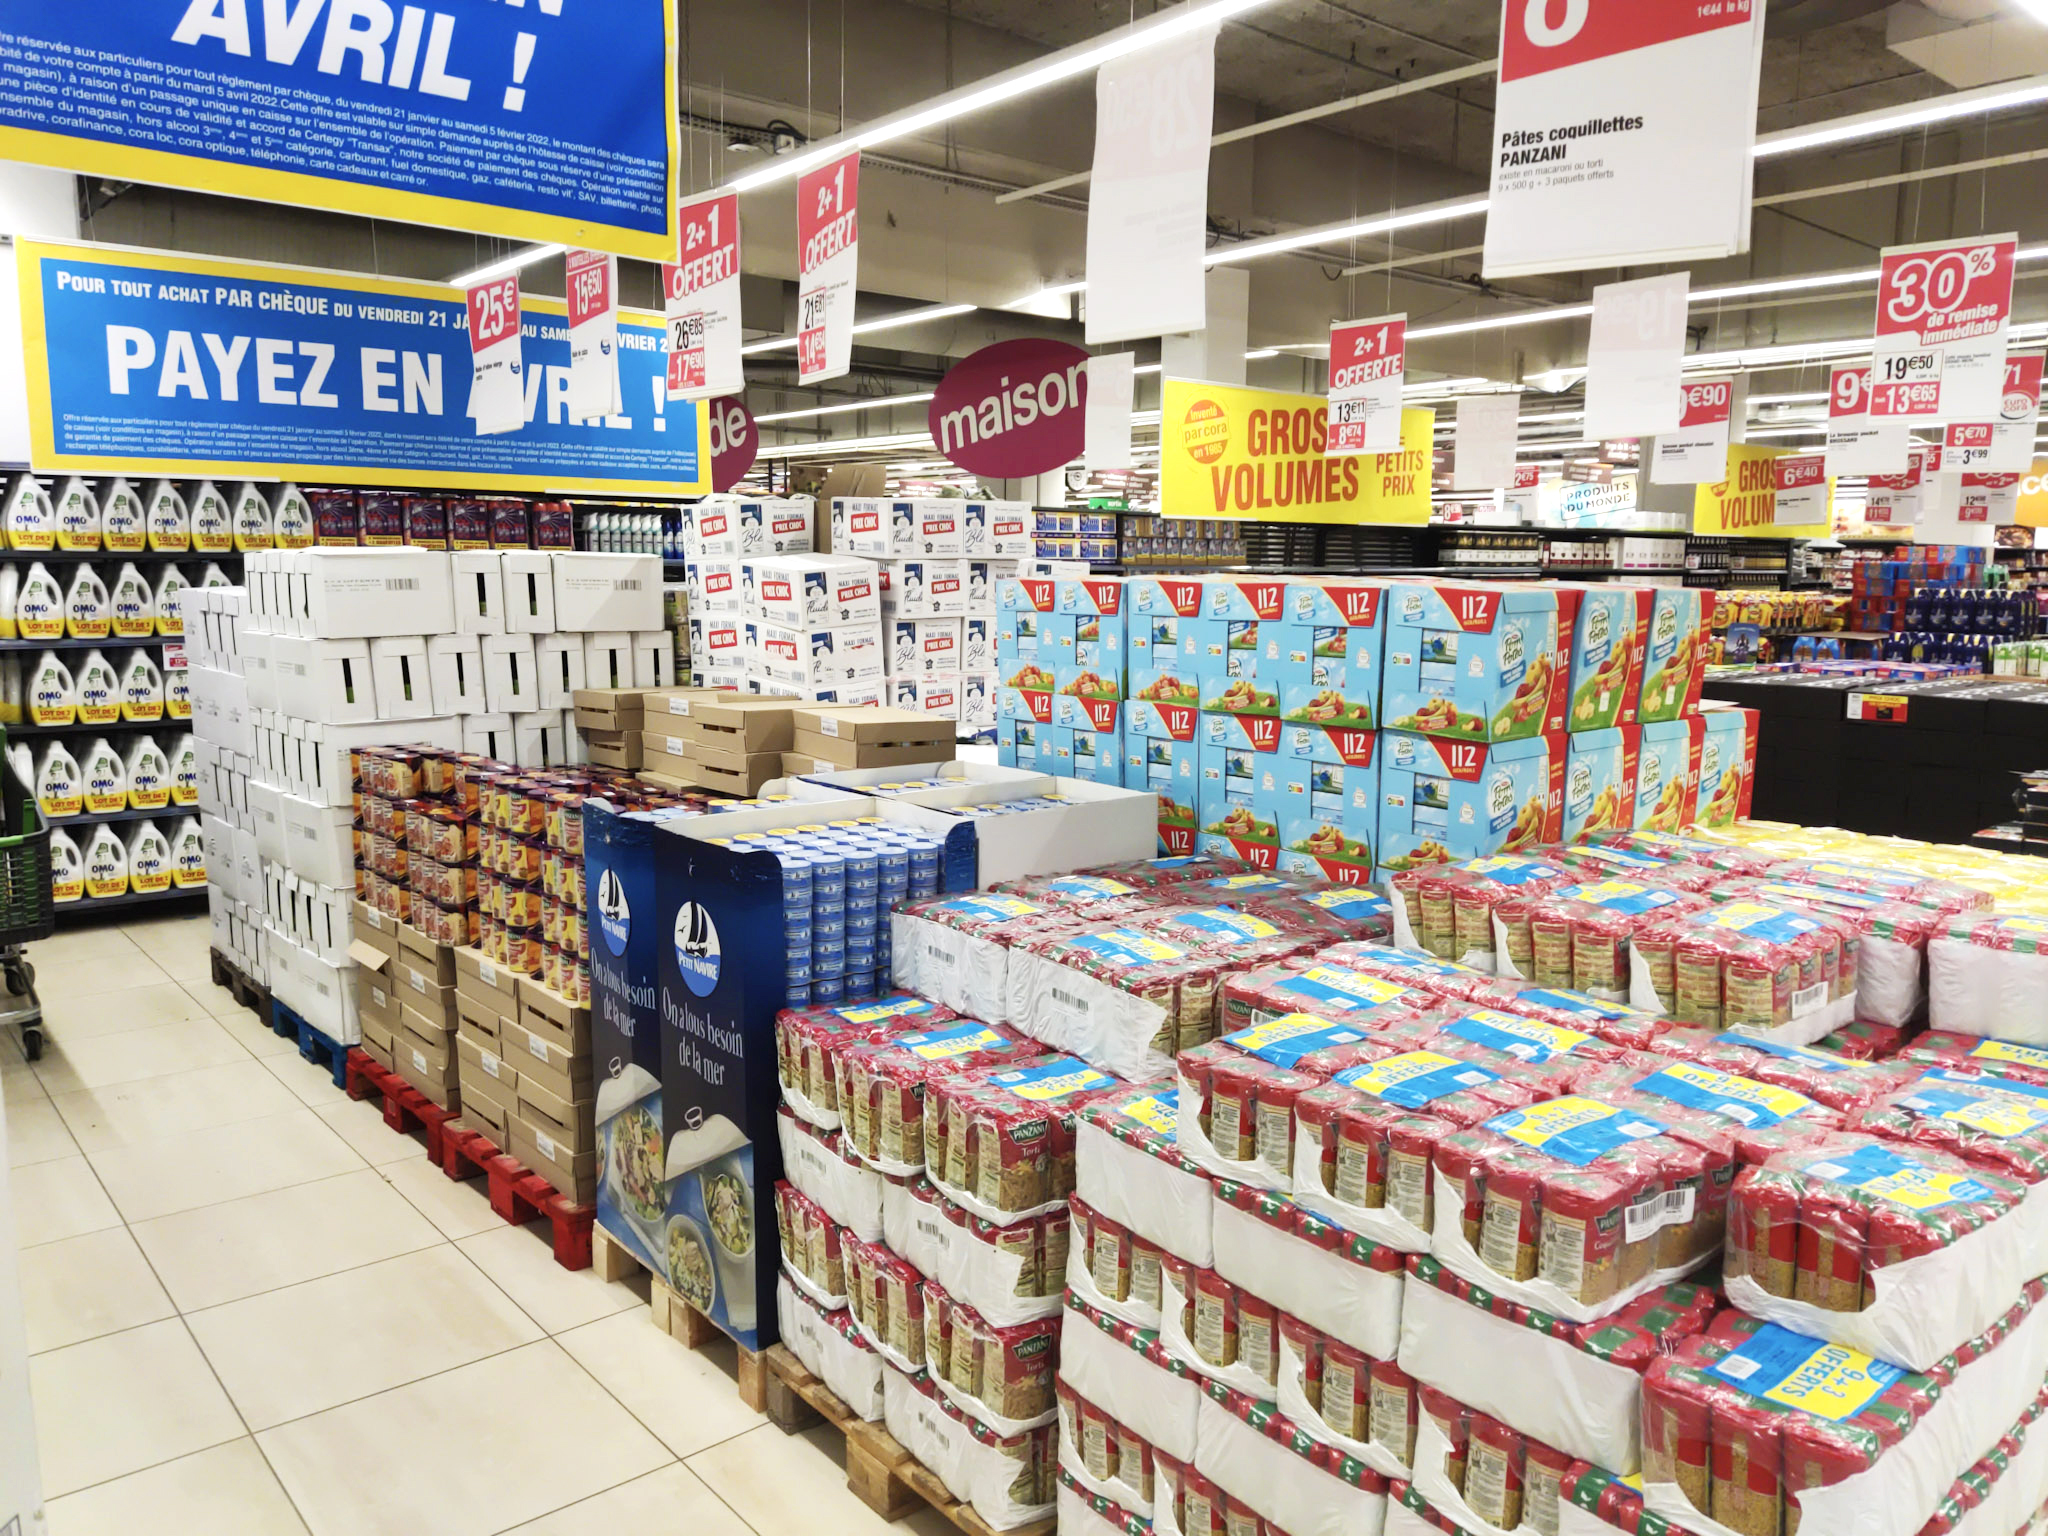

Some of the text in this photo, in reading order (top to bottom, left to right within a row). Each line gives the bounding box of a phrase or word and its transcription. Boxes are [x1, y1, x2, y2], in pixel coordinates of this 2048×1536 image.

[1726, 1, 1736, 13] le
[24, 50, 248, 101] de votre compte partir du mardi avril
[16, 35, 71, 53] réservée
[73, 46, 96, 58] aux
[98, 51, 163, 71] particuliers
[165, 64, 192, 76] pour
[193, 68, 215, 81] tout
[217, 74, 271, 92] règlement
[273, 86, 291, 96] par
[292, 89, 333, 105] chèque,
[335, 97, 348, 107] du
[350, 101, 392, 115] vendredi
[394, 108, 404, 118] 21
[408, 111, 440, 124] janvier
[441, 118, 453, 127] au
[454, 121, 488, 133] samedi
[489, 126, 495, 135] 5
[497, 127, 525, 140] février
[553, 138, 560, 147] le
[562, 141, 595, 155] montant
[597, 148, 611, 158] des
[612, 152, 646, 166] chèques
[647, 159, 664, 169] sera
[23, 81, 232, 125] pièce d'identité en cours de validité
[80, 76, 118, 90] raison
[149, 89, 199, 107] passage
[201, 99, 238, 113] unique
[1501, 115, 1643, 149] Pâtes coquillettes
[1500, 144, 1567, 168] PANZANI
[1498, 158, 1604, 181] existe en macaroni ou torti
[1511, 180, 1527, 190] 500
[1545, 177, 1551, 186] 3
[1552, 173, 1585, 187] paquets
[1587, 169, 1614, 182] offerts
[805, 209, 856, 274] OFFERT
[672, 244, 734, 300] OFFERT
[1888, 246, 1996, 322] 30%
[57, 270, 105, 294] POUR
[111, 280, 152, 298] TOUT
[158, 284, 209, 304] ACHAT
[216, 287, 252, 308] PAR
[258, 289, 328, 316] CHÈQUE
[334, 302, 352, 318] DU
[358, 304, 424, 325] VENDREDI
[428, 310, 446, 328] 21
[475, 281, 515, 340] 25€
[1927, 303, 1998, 329] de remise
[521, 324, 572, 343] AU SAME
[676, 318, 704, 350] 26€85
[1922, 319, 1998, 346] immédiate
[105, 324, 339, 409] PAYEZ
[360, 346, 444, 416] EN
[1334, 353, 1402, 389] OFFERTE
[1884, 355, 1934, 381] 19€50
[940, 357, 1090, 455] maison
[1886, 384, 1937, 414] 13€65
[1337, 402, 1365, 422] 13€11
[1203, 423, 1227, 437] cora
[1247, 407, 1328, 457] GROS
[1339, 424, 1362, 445] 8€74
[1954, 425, 1987, 446] 5€70
[1193, 448, 1204, 459] en
[1376, 450, 1424, 475] PETITS
[1963, 449, 1988, 465] 3€99
[1211, 456, 1359, 512] VOLUMES
[1382, 474, 1416, 498] PRIX
[1784, 466, 1818, 486] 6€40
[1566, 480, 1630, 502] PRODUITS
[1585, 492, 1631, 510] MONDE
[16, 515, 40, 524] OMO
[774, 513, 805, 521] MAXI FORMAT
[1720, 493, 1775, 530] VOLUM
[774, 520, 803, 532] PRIX CHOC
[763, 585, 790, 597] PRIX CHOC
[840, 586, 869, 601] PRIX CHOC
[851, 577, 869, 586] FORMAT
[1035, 584, 1050, 603] 112
[24, 604, 48, 613] OMO
[1177, 587, 1195, 606] 112
[1346, 592, 1370, 616] 112
[1462, 596, 1488, 619] 112
[38, 691, 62, 701] OMO
[1451, 746, 1477, 768] 112
[45, 782, 69, 791] OMO
[678, 952, 718, 981] PETIT NAVIRE
[620, 971, 657, 1011] besoin
[603, 992, 612, 1022] de
[620, 1012, 637, 1038] mer
[662, 986, 678, 1028] On
[679, 1007, 684, 1029] a
[706, 1012, 743, 1058] besoin
[679, 1036, 725, 1086] de la mer
[1013, 1123, 1045, 1140] PANZANI
[1534, 1109, 1606, 1135] OFFERTS
[1781, 1347, 1851, 1399] OFFERTS
